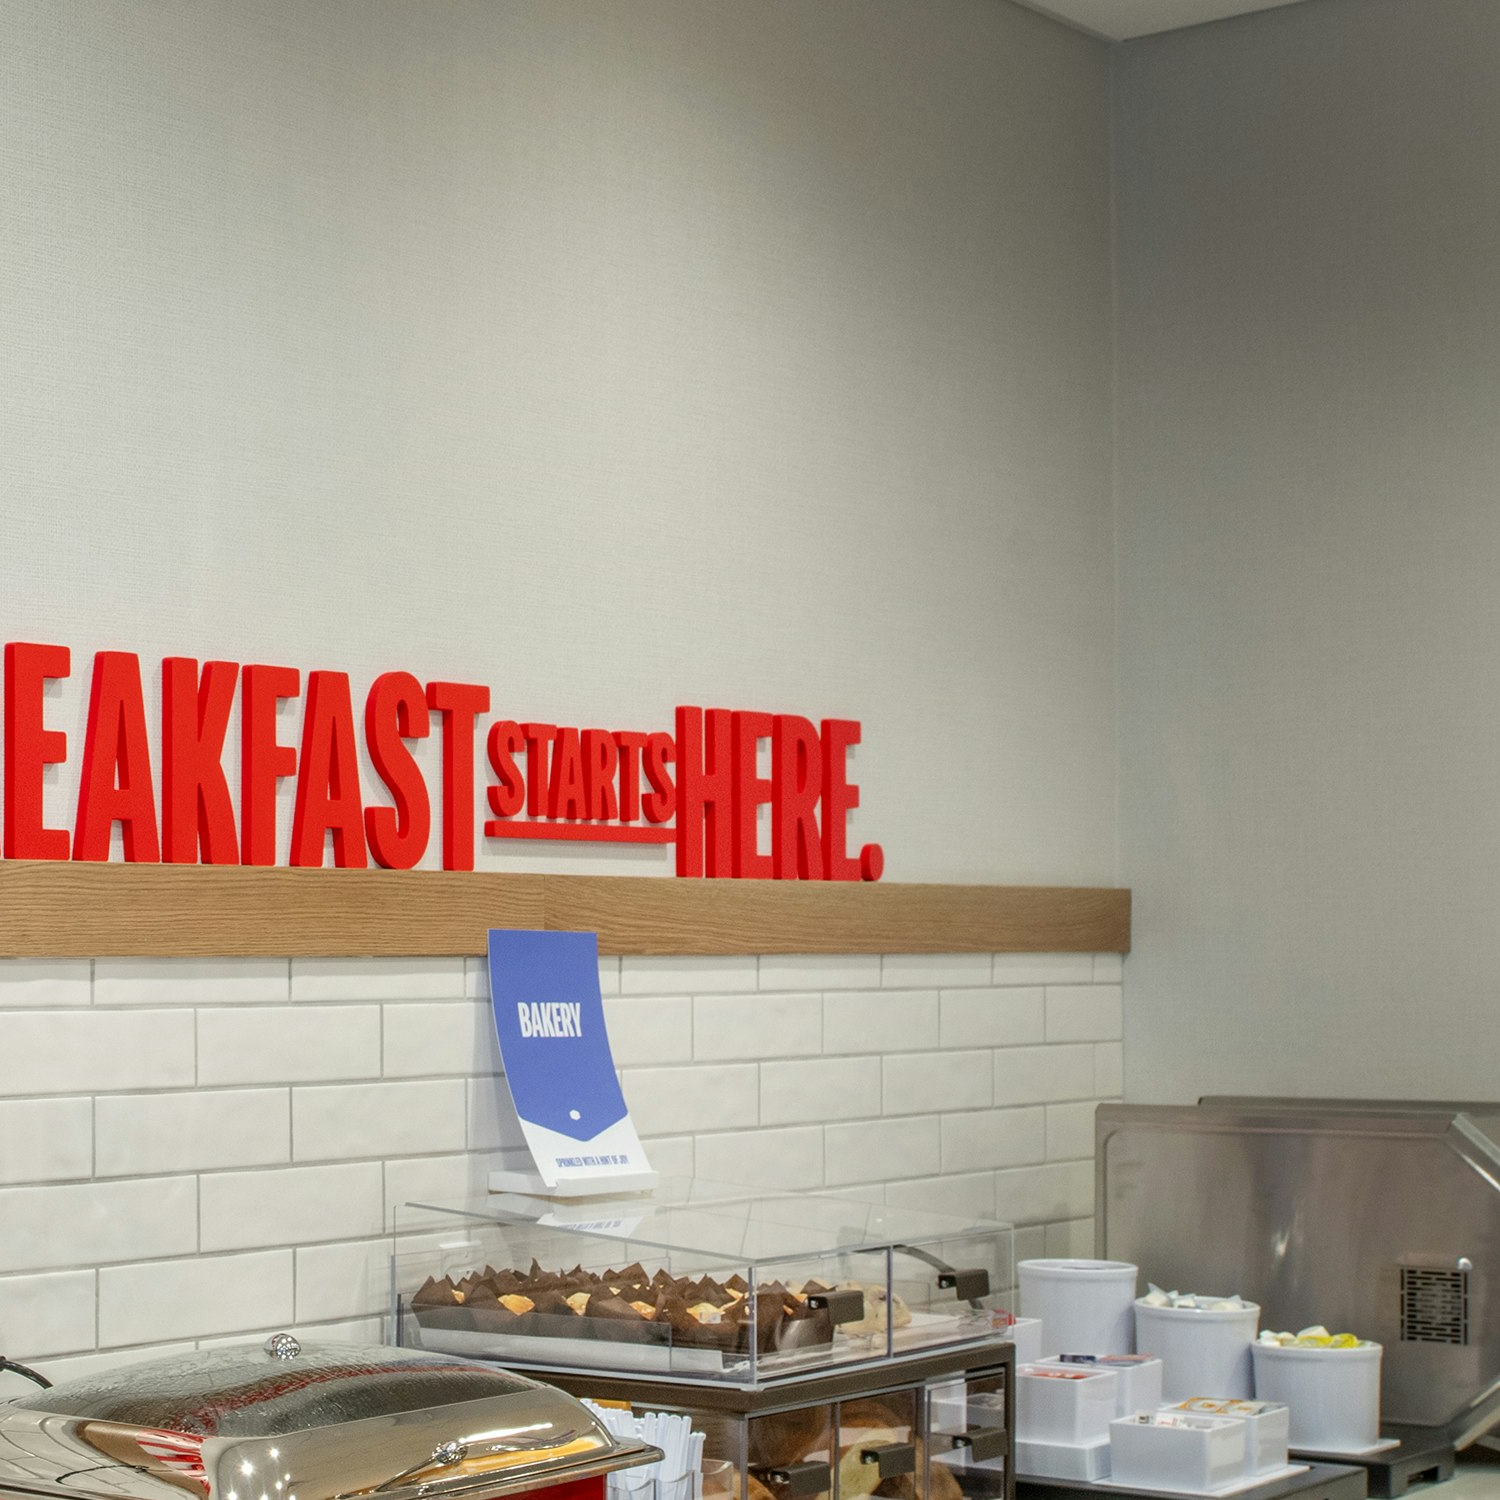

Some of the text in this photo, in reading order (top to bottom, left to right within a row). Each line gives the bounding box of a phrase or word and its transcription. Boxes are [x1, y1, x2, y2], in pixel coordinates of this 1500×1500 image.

[487, 720, 676, 824] STARTS
[675, 705, 884, 882] HERE.
[517, 1002, 582, 1038] BAKERY
